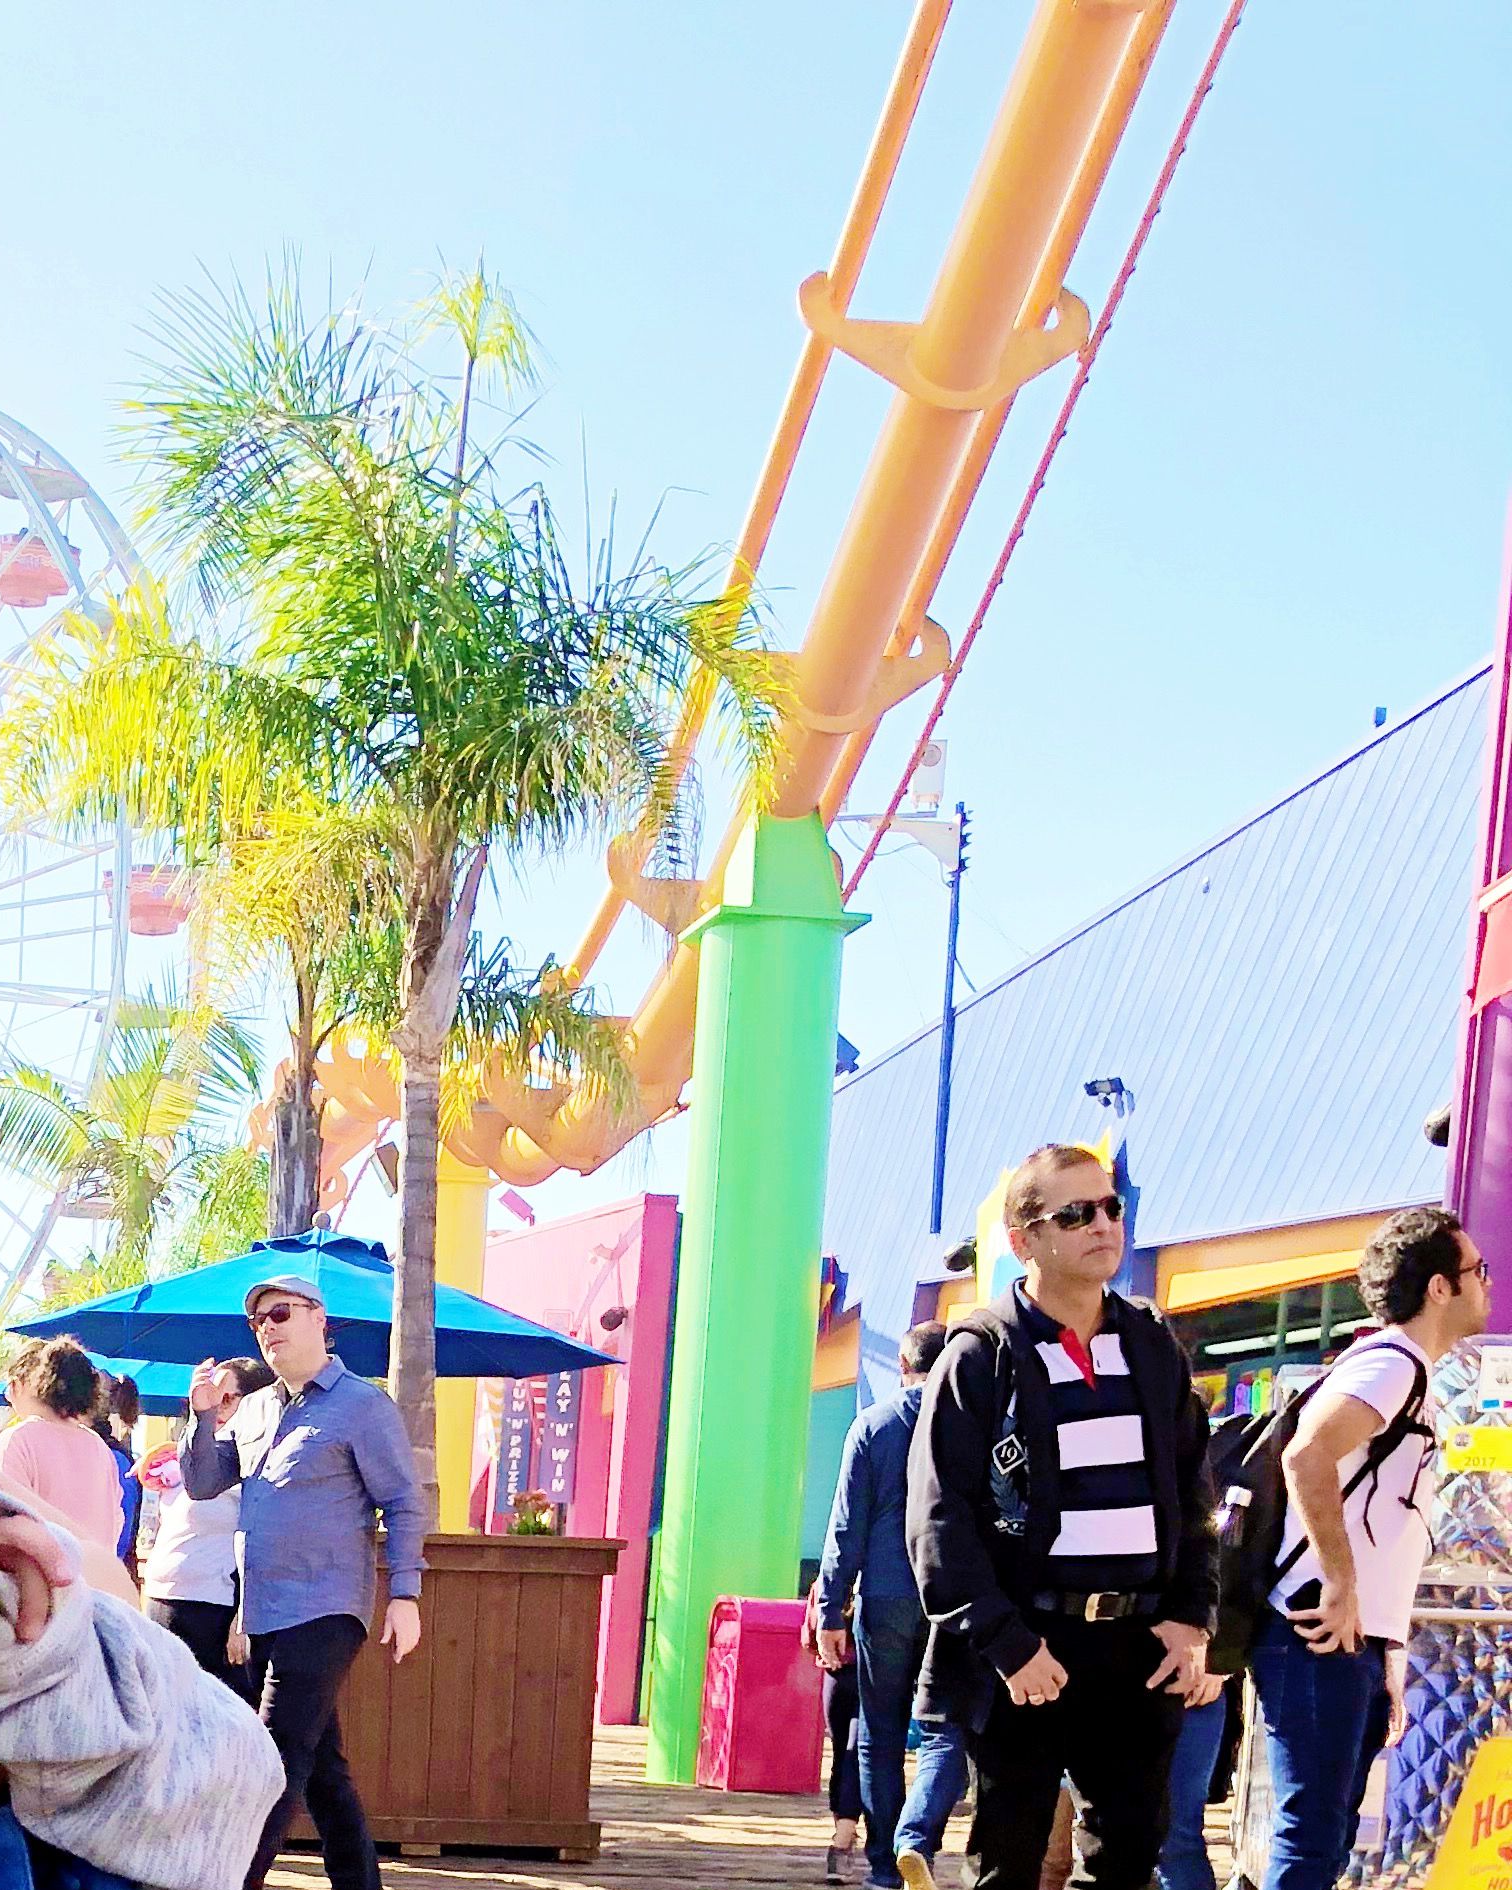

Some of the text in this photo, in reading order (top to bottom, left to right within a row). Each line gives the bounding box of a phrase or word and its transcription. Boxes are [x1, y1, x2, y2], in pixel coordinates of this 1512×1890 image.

[999, 1445, 1018, 1464] 19
[1463, 1456, 1497, 1468] 2017
[551, 1447, 570, 1493] WIN
